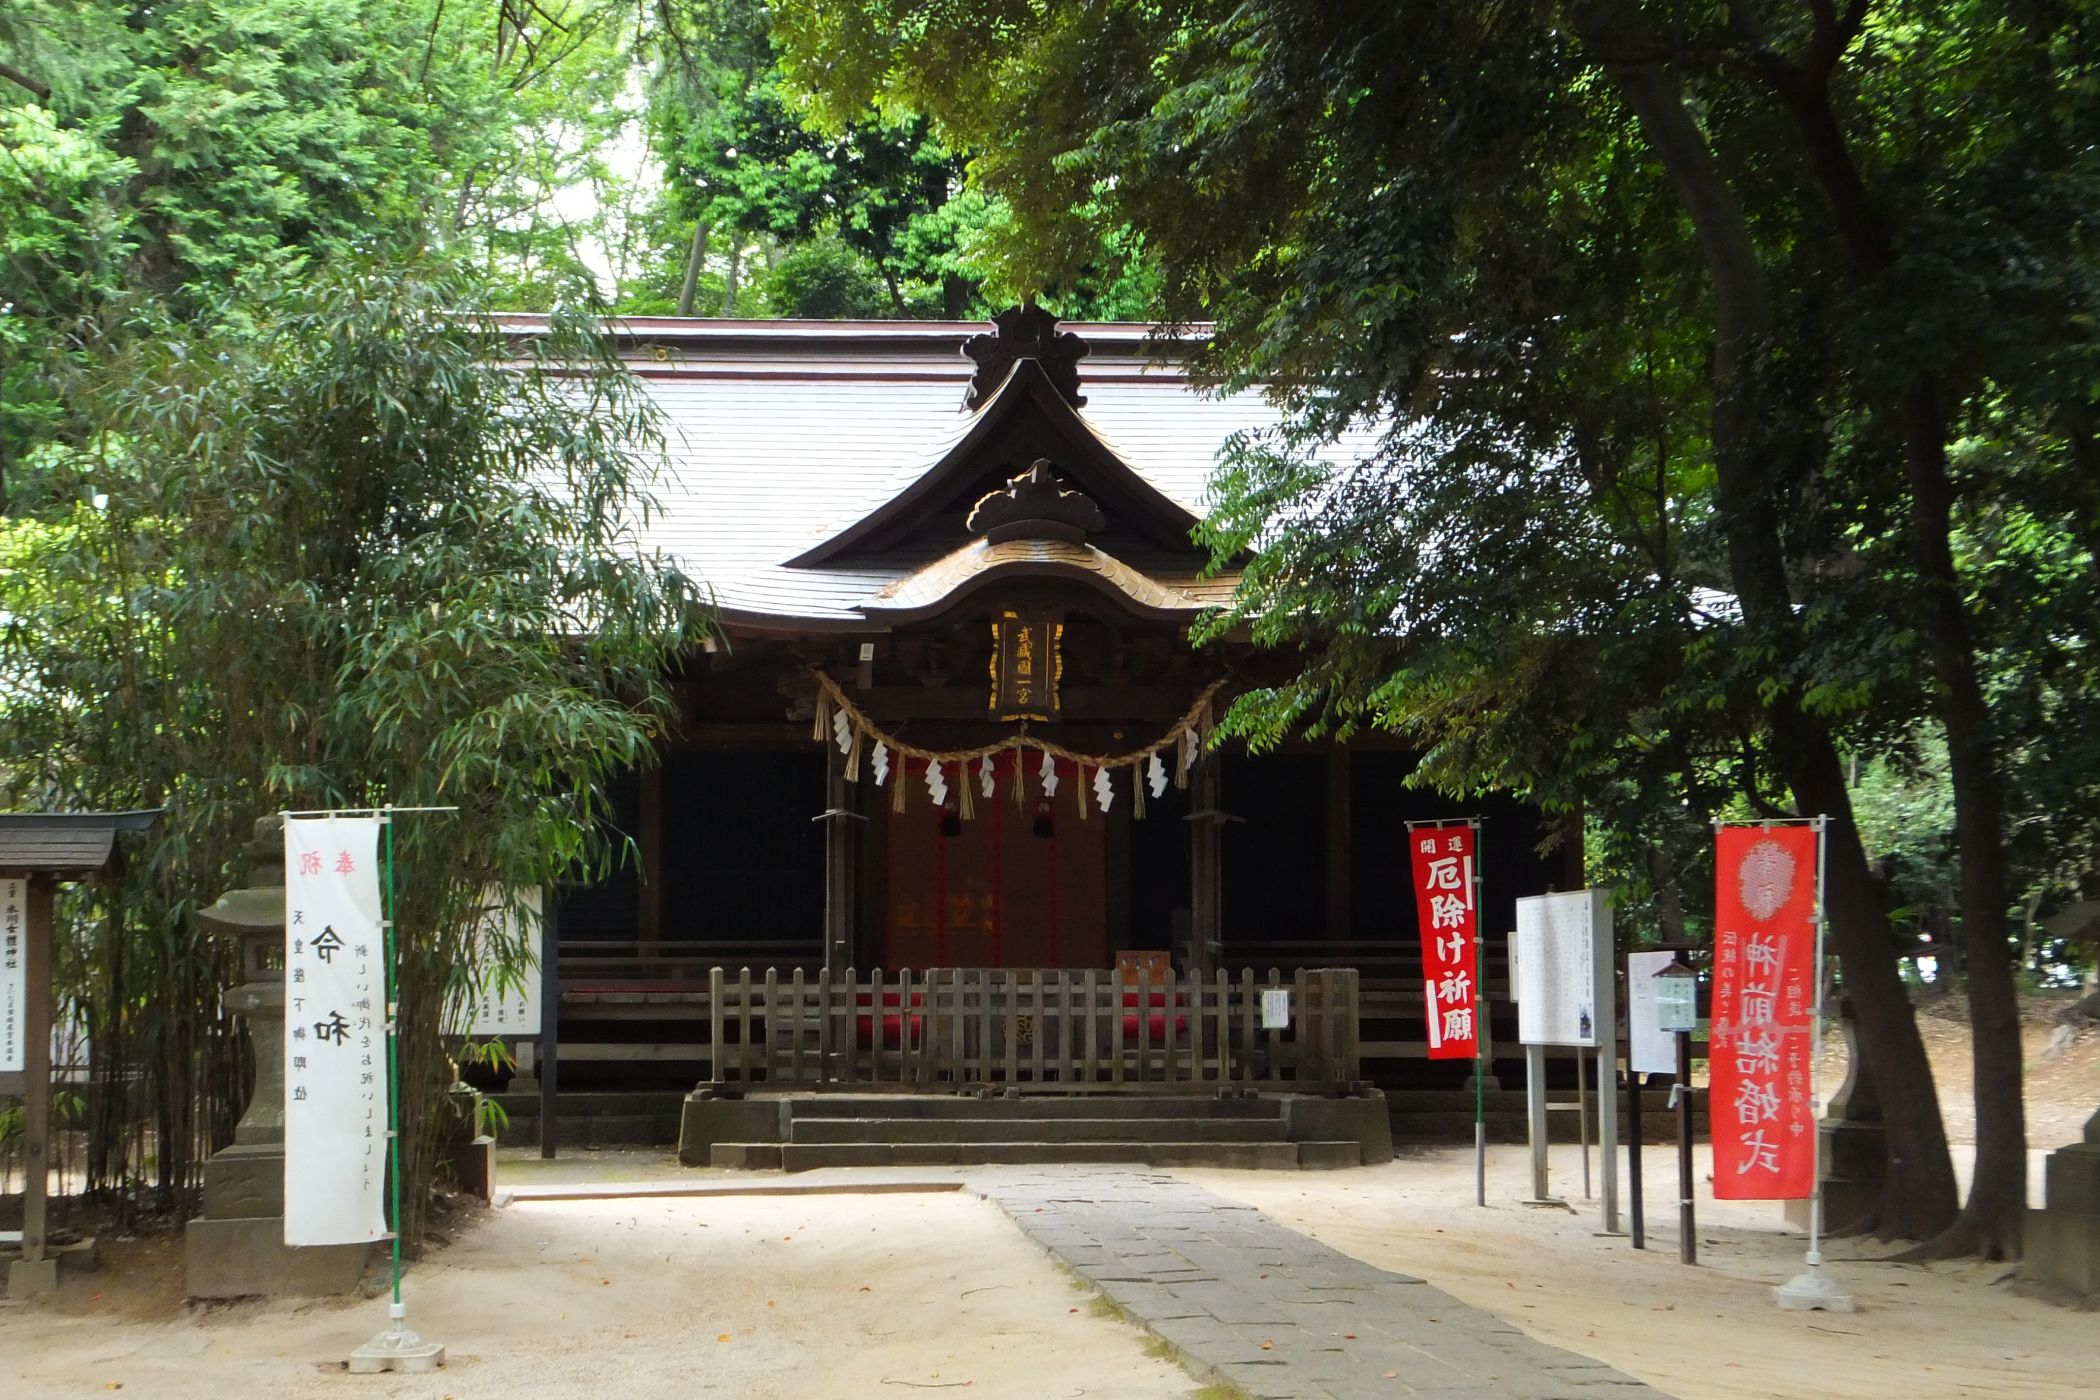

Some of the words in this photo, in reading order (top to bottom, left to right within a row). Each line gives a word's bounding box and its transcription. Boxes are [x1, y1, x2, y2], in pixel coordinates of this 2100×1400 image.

[1420, 836, 1464, 855] 開運
[1426, 856, 1473, 1041] 厄除け祈願
